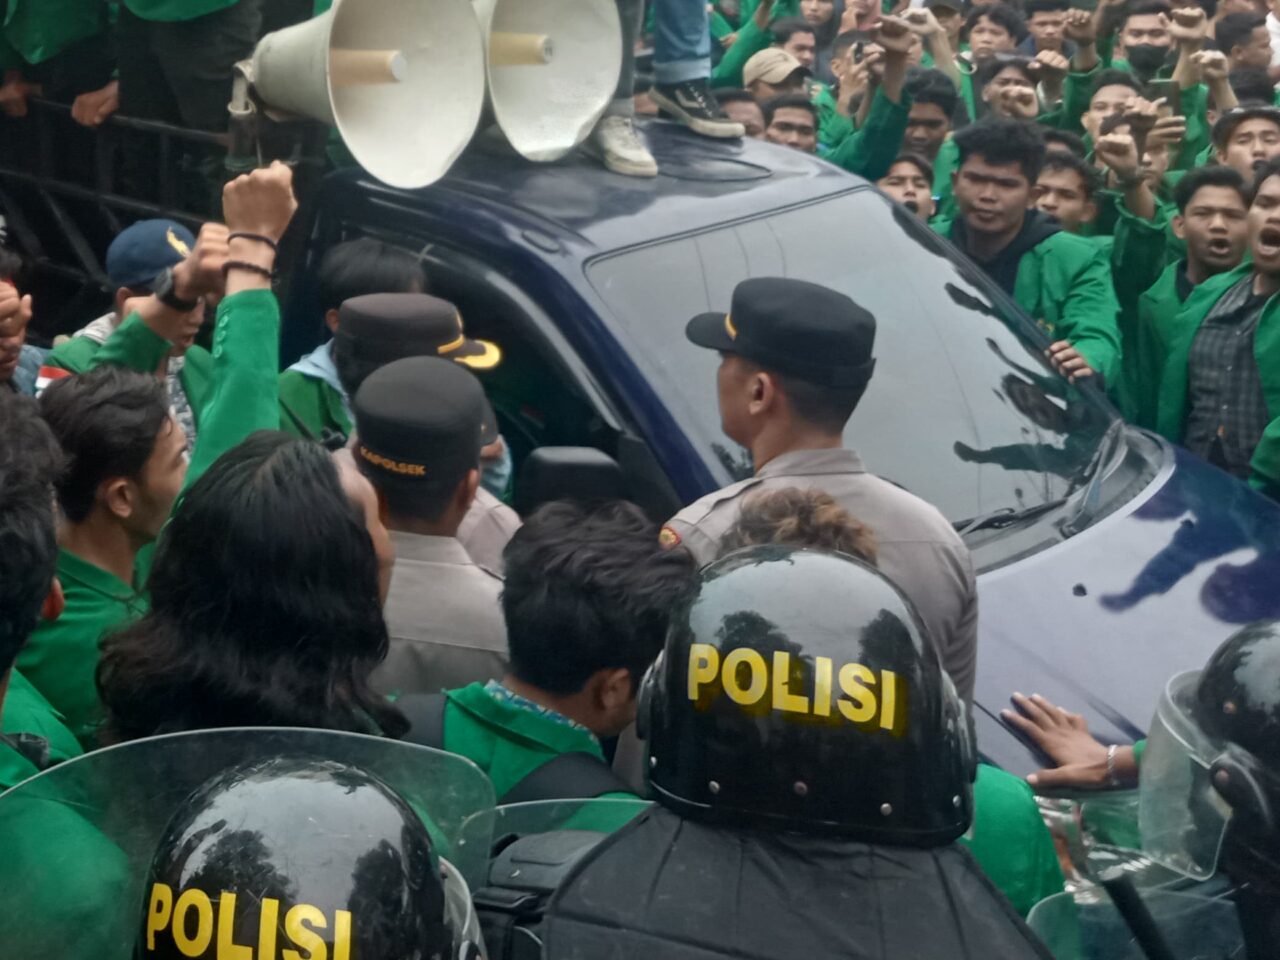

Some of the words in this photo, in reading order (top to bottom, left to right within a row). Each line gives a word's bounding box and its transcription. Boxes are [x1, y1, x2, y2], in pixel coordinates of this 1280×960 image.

[360, 445, 426, 476] KAPOLSEK
[687, 643, 896, 730] POLISI
[147, 883, 352, 960] POLISI
